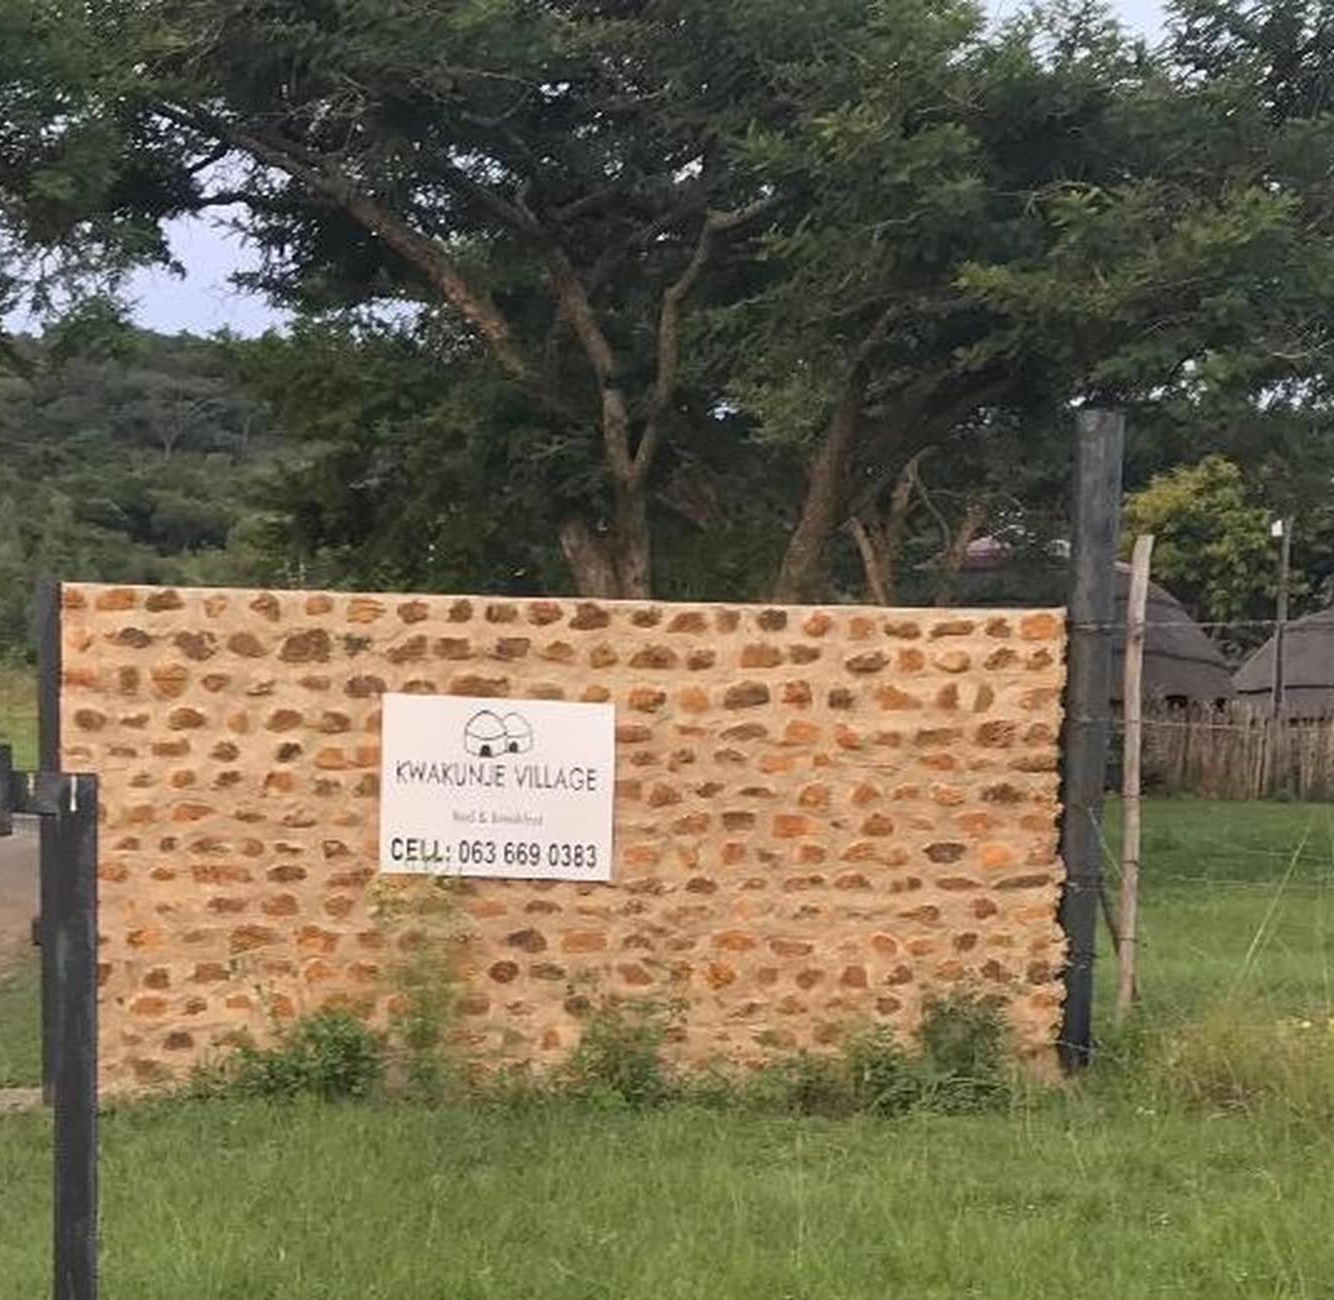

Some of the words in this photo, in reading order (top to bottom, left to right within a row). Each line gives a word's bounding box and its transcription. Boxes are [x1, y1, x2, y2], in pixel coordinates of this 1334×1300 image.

[396, 760, 505, 788] KWAKUNJE
[514, 765, 597, 791] VILLAGE
[479, 812, 488, 823] &
[391, 838, 451, 862] CELL:
[459, 840, 496, 864] 063
[504, 842, 540, 866] 669
[549, 844, 598, 868] 0383
